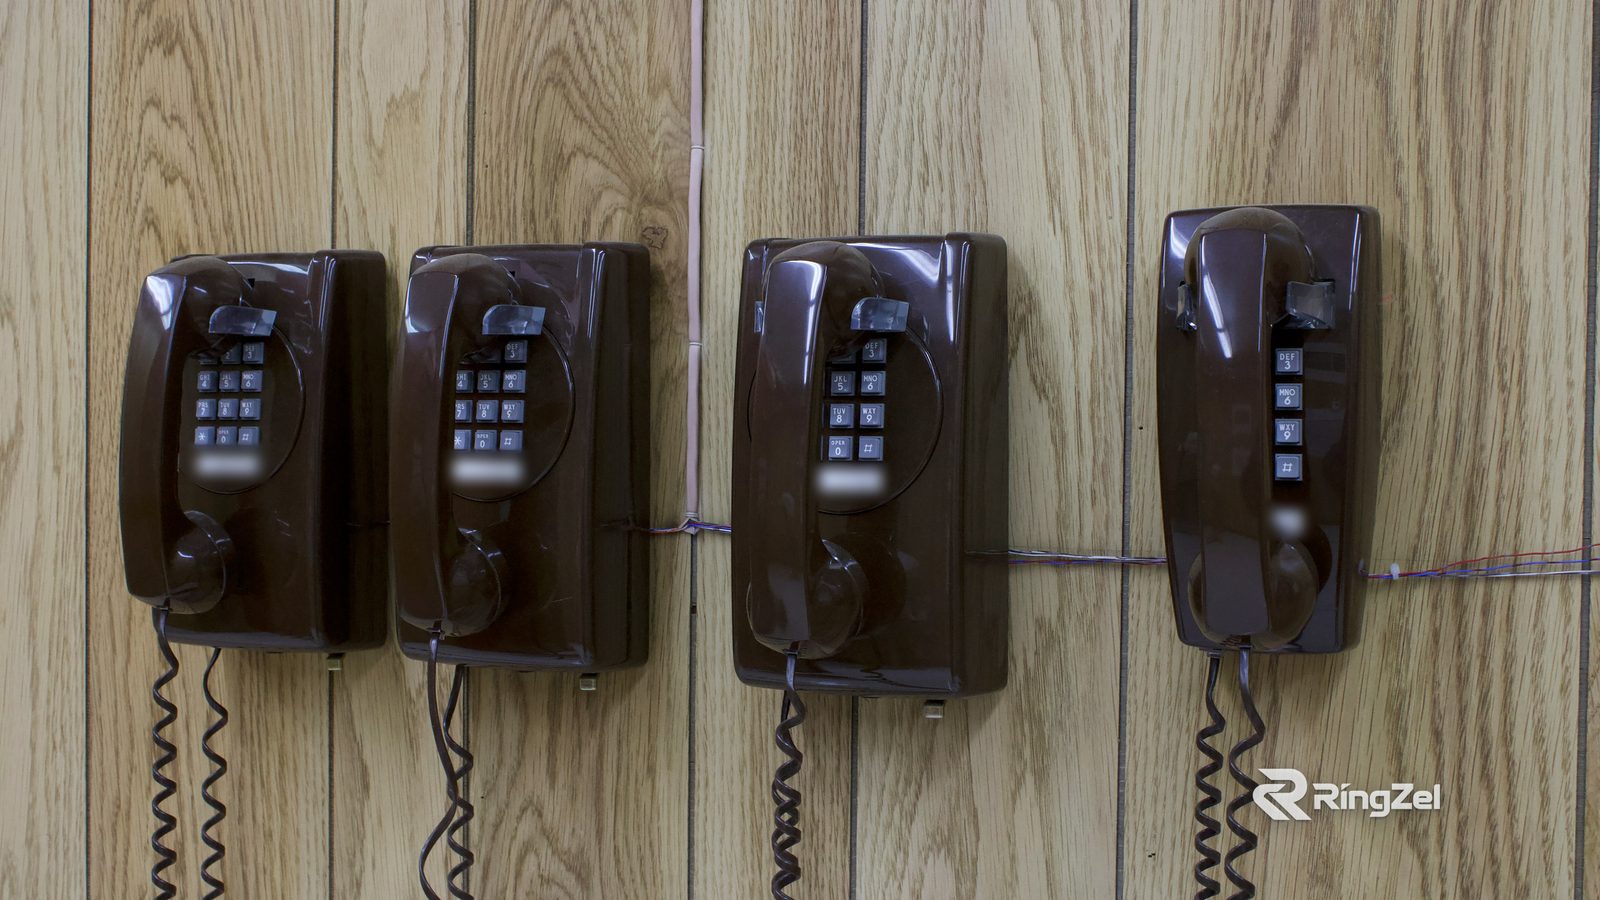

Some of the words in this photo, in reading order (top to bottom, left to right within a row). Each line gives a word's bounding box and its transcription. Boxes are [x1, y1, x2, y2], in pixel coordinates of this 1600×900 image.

[225, 351, 230, 360] 2
[247, 351, 253, 359] 3
[510, 350, 516, 358] 3
[869, 350, 875, 358] 3
[1279, 352, 1296, 361] DEF
[1284, 360, 1291, 370] 3
[833, 375, 848, 383] JKL
[224, 380, 230, 388] 5
[245, 380, 252, 388] 6
[483, 380, 489, 389] 5
[508, 380, 514, 389] 6
[837, 382, 844, 391] 5
[867, 382, 874, 391] 6
[1279, 388, 1296, 396] MNO
[1284, 396, 1292, 405] 6
[201, 407, 206, 416] 7
[222, 407, 228, 416] 8
[244, 407, 250, 416] 9
[456, 409, 462, 418] 7
[481, 410, 487, 418] 8
[506, 410, 512, 418] 9
[832, 407, 846, 415] TUV
[862, 407, 877, 415] WXY
[836, 414, 843, 423] 8
[866, 414, 873, 423] 9
[1279, 423, 1295, 431] WXY
[1283, 430, 1291, 440] 9
[480, 440, 486, 449] 0
[835, 447, 842, 456] 0
